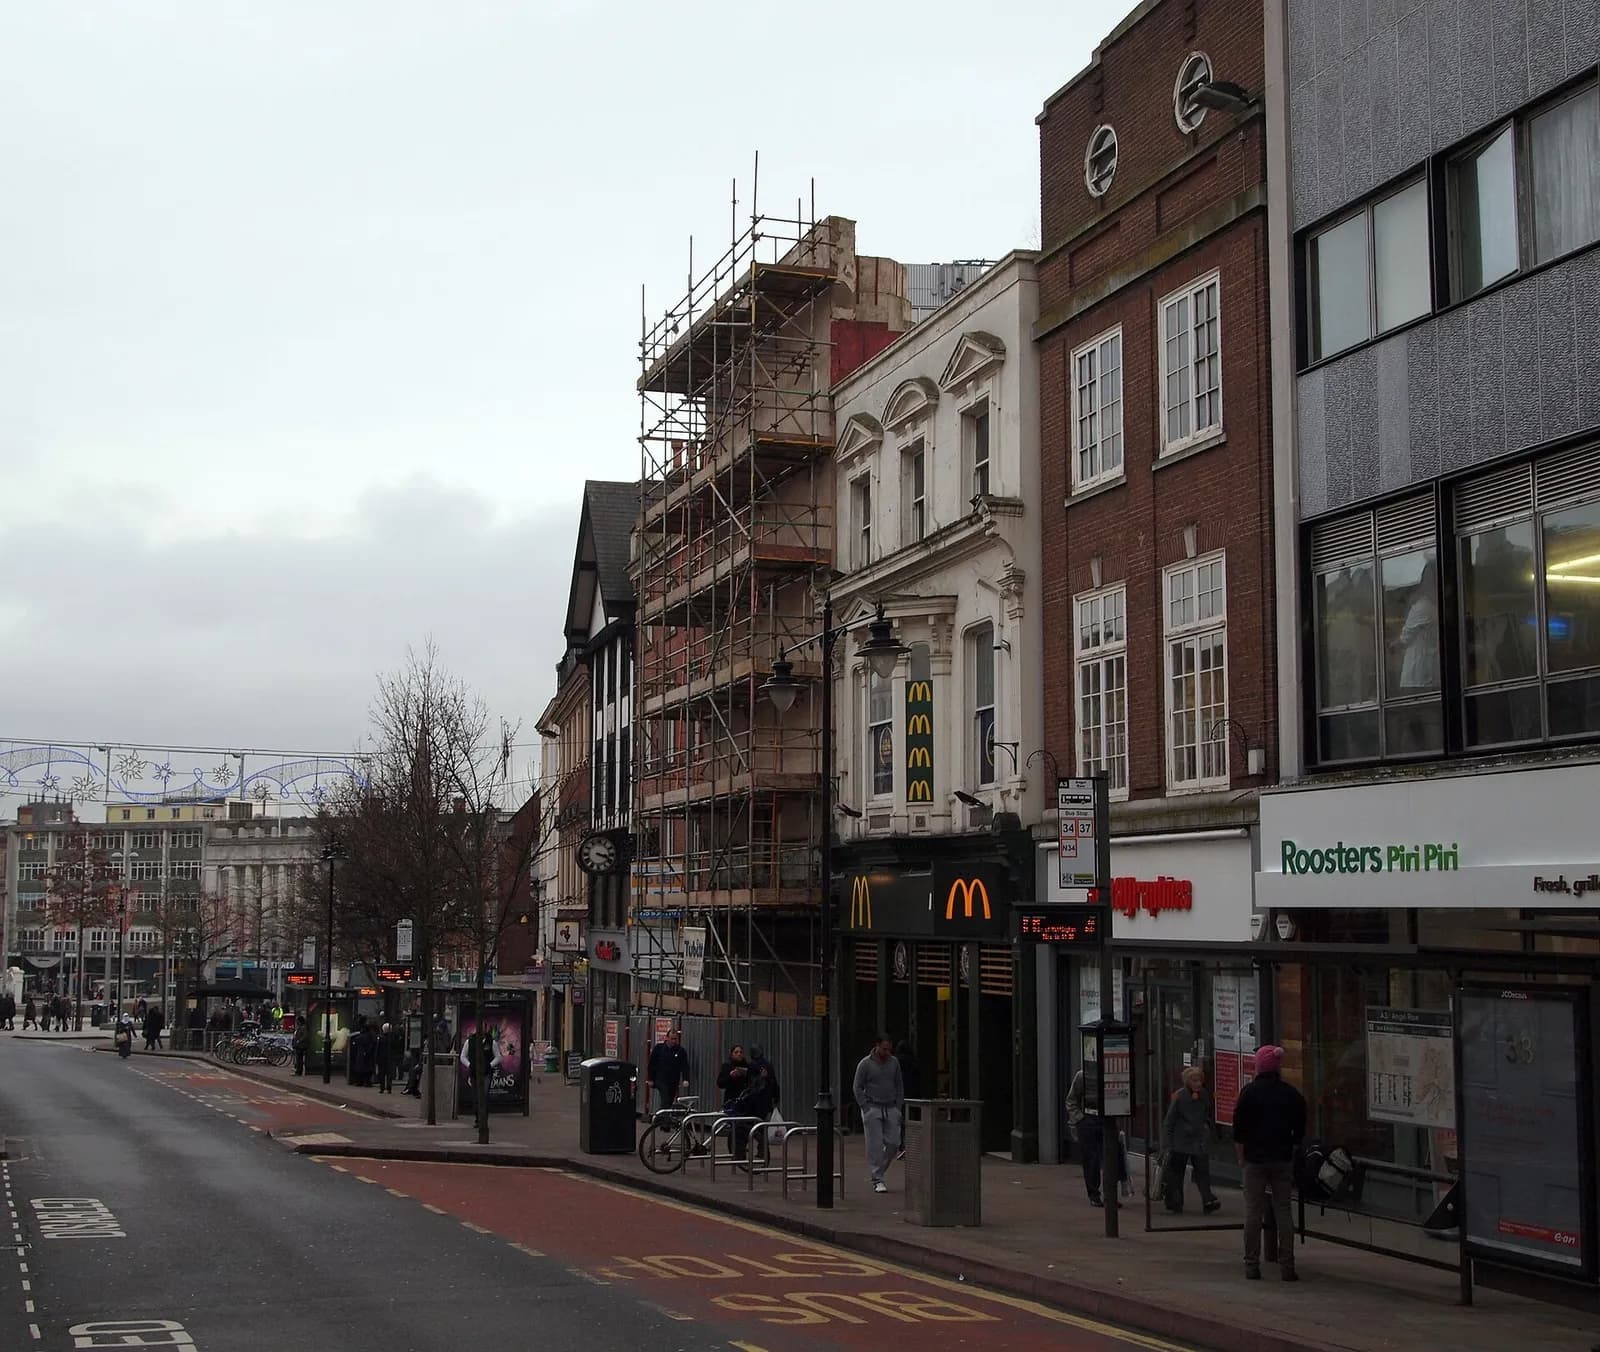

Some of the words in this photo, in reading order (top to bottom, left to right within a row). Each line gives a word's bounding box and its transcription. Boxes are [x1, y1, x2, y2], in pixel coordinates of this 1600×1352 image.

[1063, 823, 1074, 833] 34
[1079, 823, 1091, 833] 37
[1281, 840, 1383, 875] Roosters
[1387, 845, 1420, 872] Piri
[1424, 843, 1458, 871] Piri
[1533, 875, 1571, 893] Fresh,
[30, 1197, 127, 1239] DISABLED
[710, 1290, 1002, 1325] BUS
